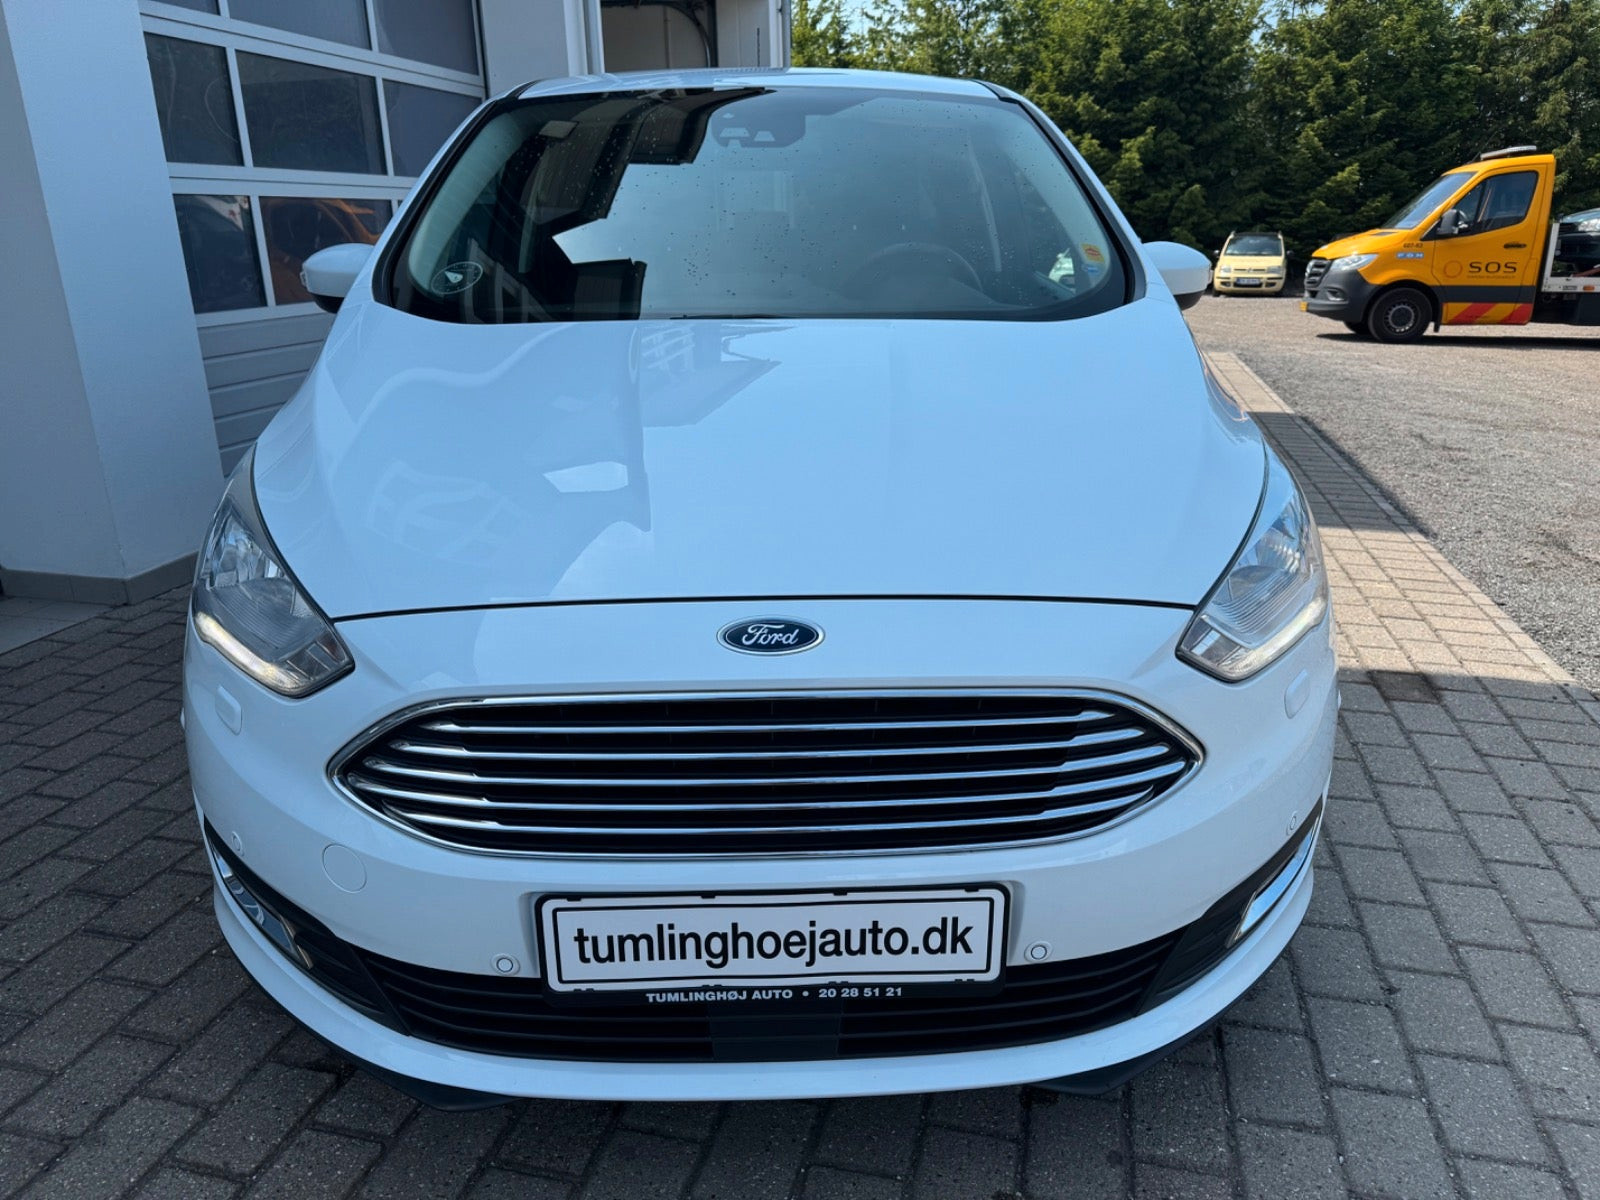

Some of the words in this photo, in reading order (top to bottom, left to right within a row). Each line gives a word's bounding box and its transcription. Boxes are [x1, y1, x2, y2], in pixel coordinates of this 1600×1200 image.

[1468, 261, 1518, 274] SOS
[742, 623, 799, 645] Ford
[574, 916, 973, 968] tumlinghoejauto.dk
[646, 990, 747, 1003] TUMLINGHØJ
[752, 989, 793, 1000] AUTO
[819, 988, 837, 998] 20
[841, 988, 859, 997] 28
[863, 987, 880, 997] 51
[885, 987, 902, 996] 21
